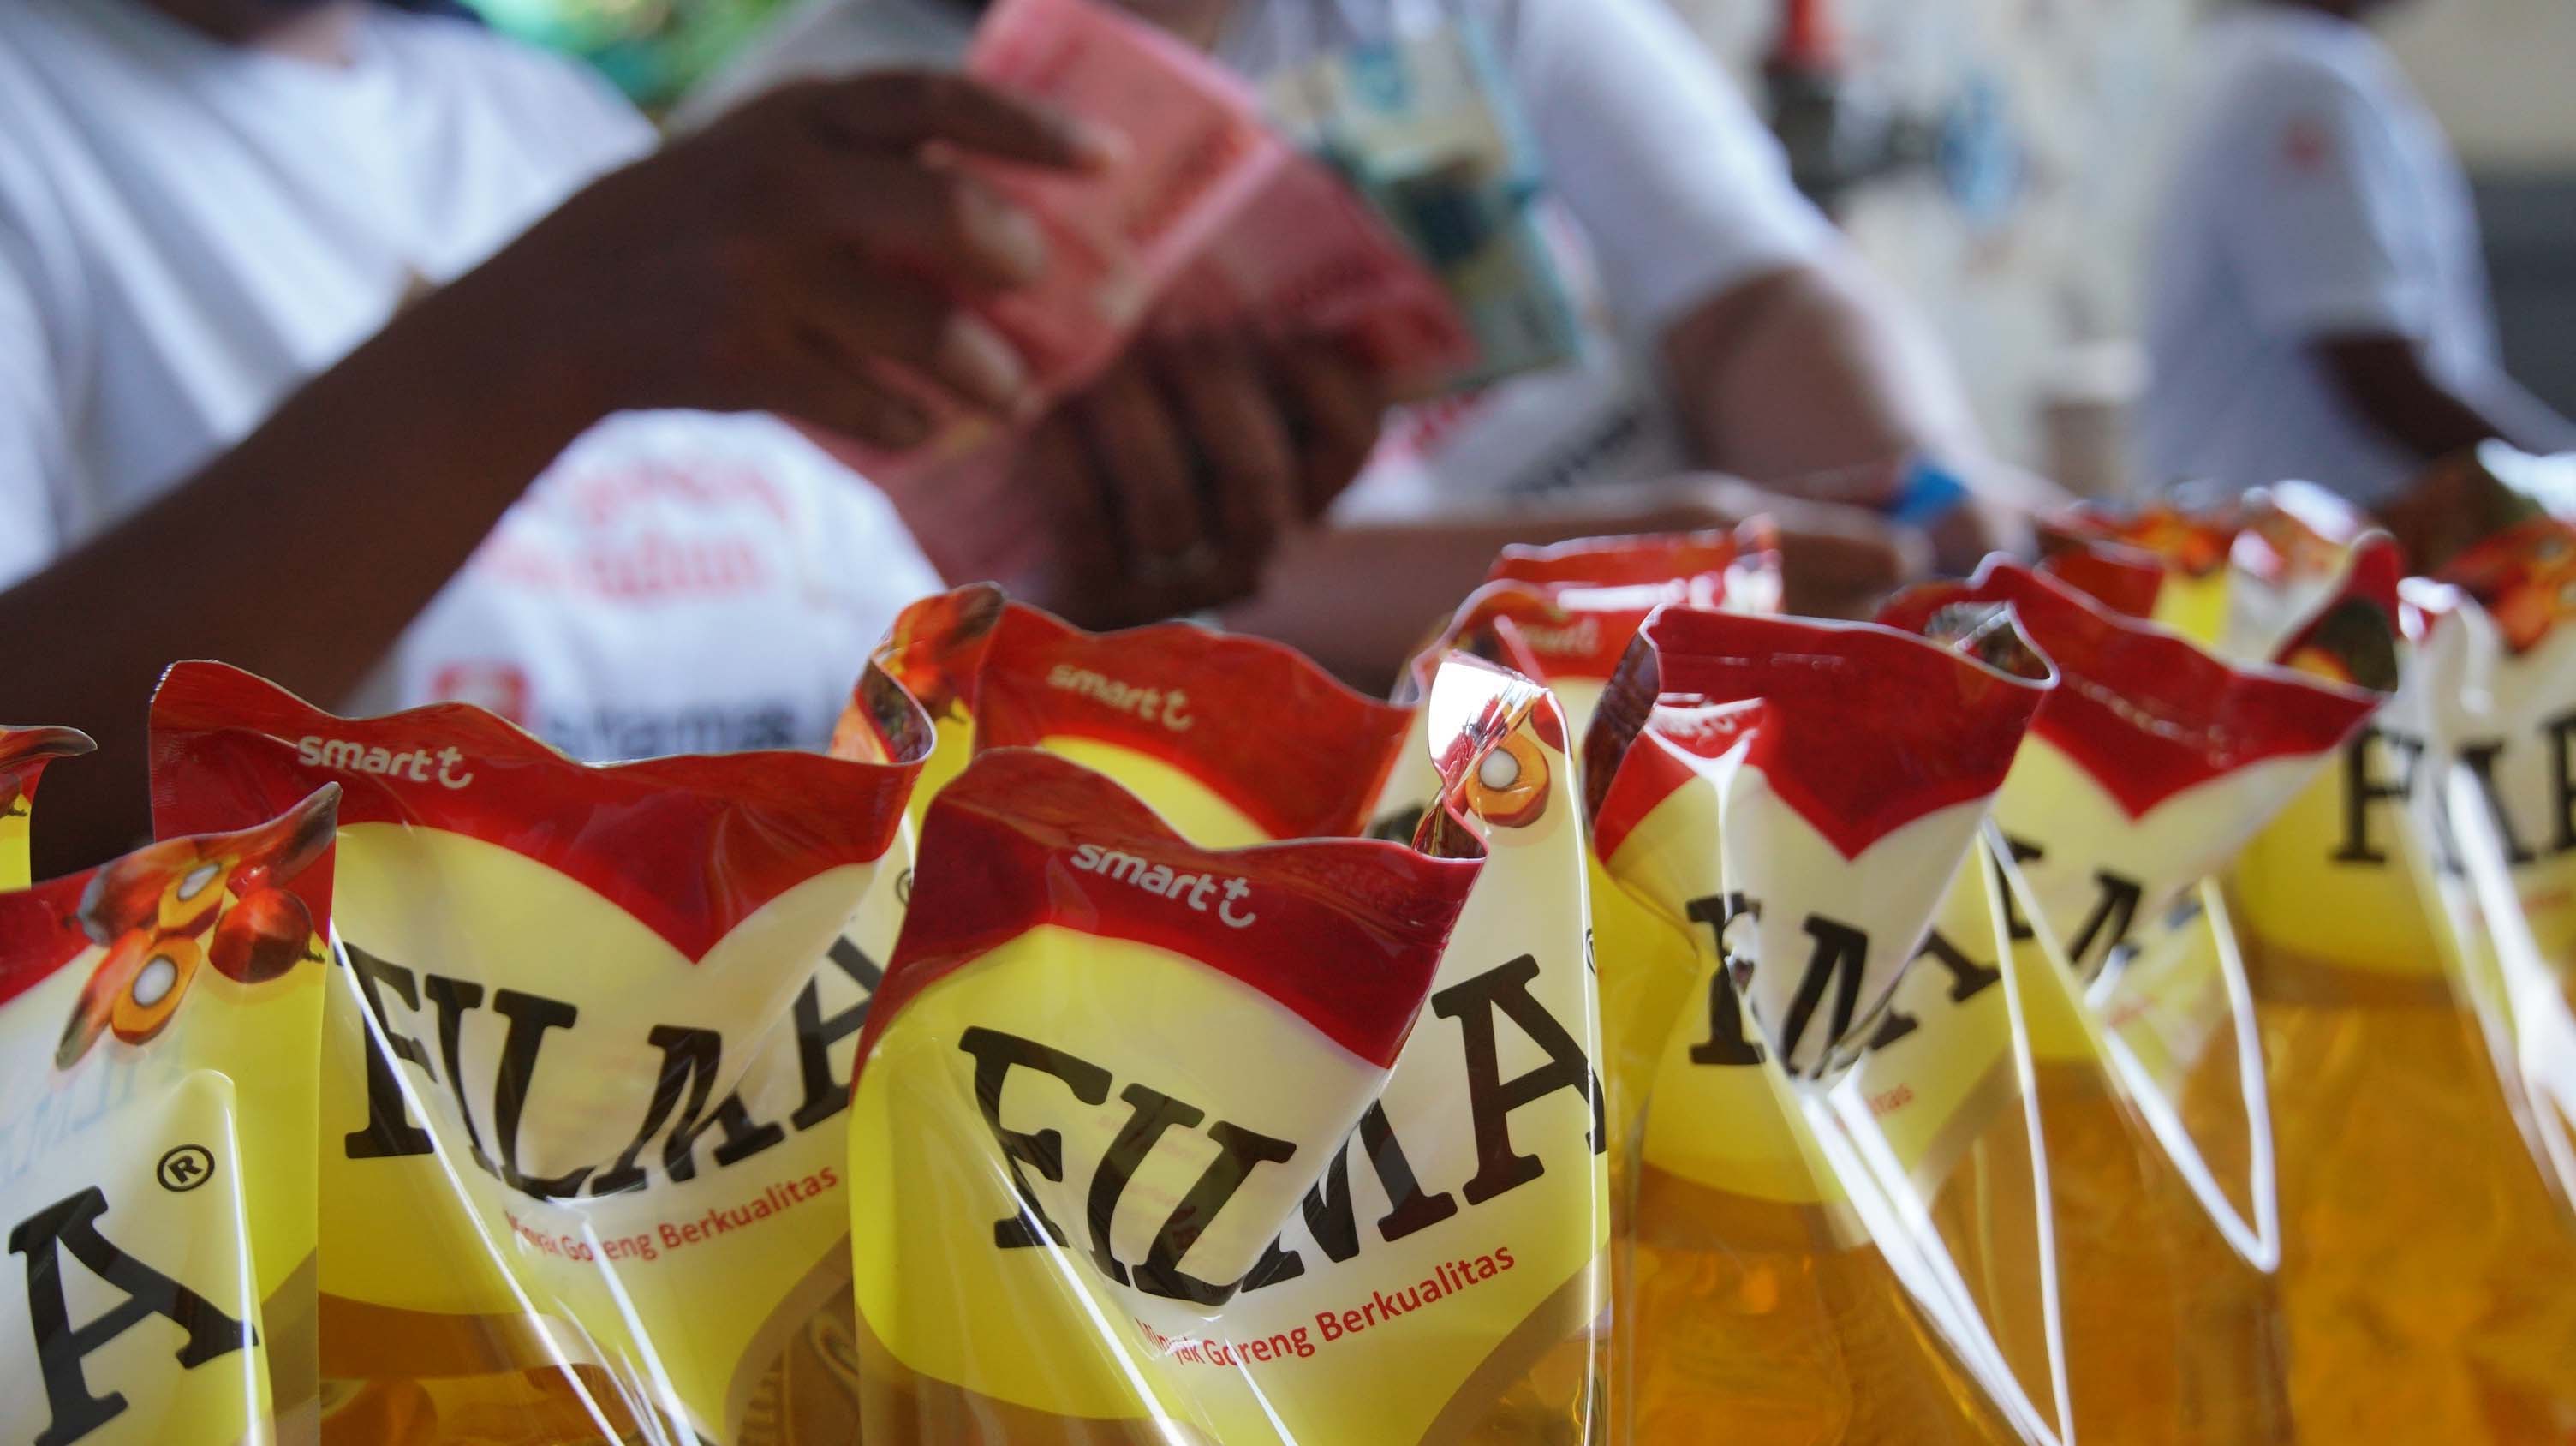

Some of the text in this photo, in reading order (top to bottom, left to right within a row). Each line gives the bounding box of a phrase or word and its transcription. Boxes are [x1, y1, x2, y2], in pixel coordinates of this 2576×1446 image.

[1046, 664, 1158, 720] smart
[299, 735, 432, 782] smart
[1070, 843, 1217, 911] smart
[657, 1165, 838, 1250] Berkualitas
[1315, 1246, 1515, 1343] Berkualitas
